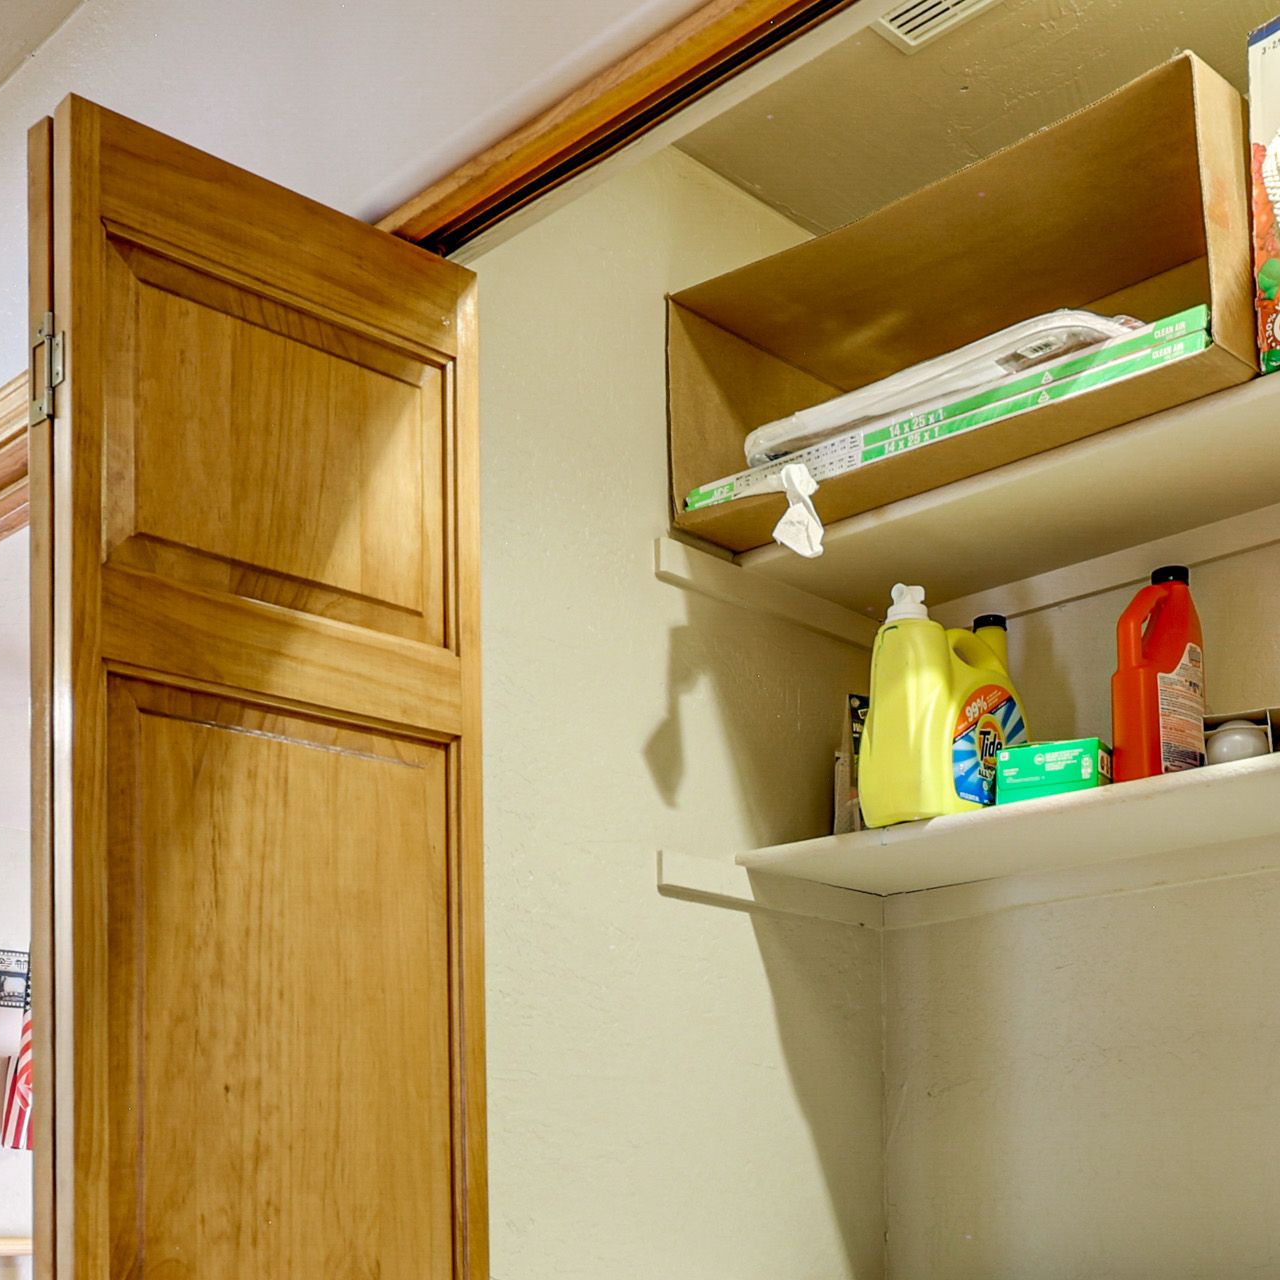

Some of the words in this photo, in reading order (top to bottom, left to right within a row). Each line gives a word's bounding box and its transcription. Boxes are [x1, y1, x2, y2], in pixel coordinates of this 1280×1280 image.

[889, 424, 900, 438] 14
[911, 415, 926, 430] 25
[884, 441, 895, 454] 14
[964, 696, 988, 722] 99%
[979, 730, 1003, 761] Tide
